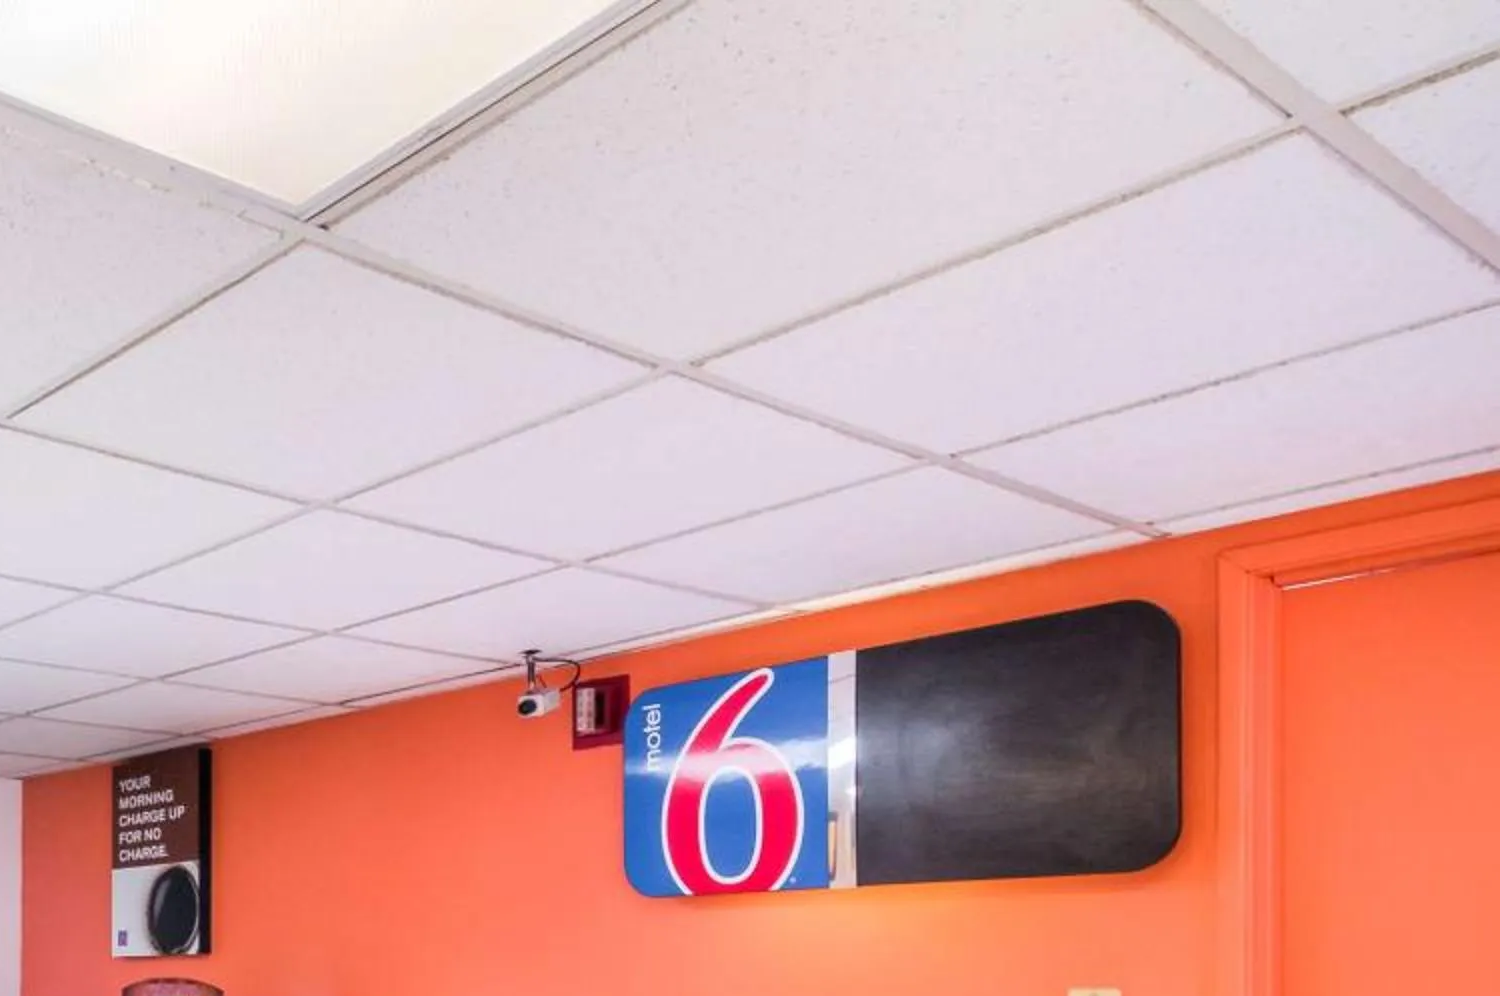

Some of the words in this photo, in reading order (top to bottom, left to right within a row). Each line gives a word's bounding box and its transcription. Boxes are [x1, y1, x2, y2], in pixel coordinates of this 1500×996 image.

[642, 703, 661, 772] motel
[119, 775, 151, 793] YOUR
[661, 667, 804, 895] 6
[119, 789, 174, 810] MORNING
[119, 808, 166, 827] CHARGE
[168, 805, 185, 820] UP
[119, 829, 142, 844] FOR
[143, 827, 162, 842] NO
